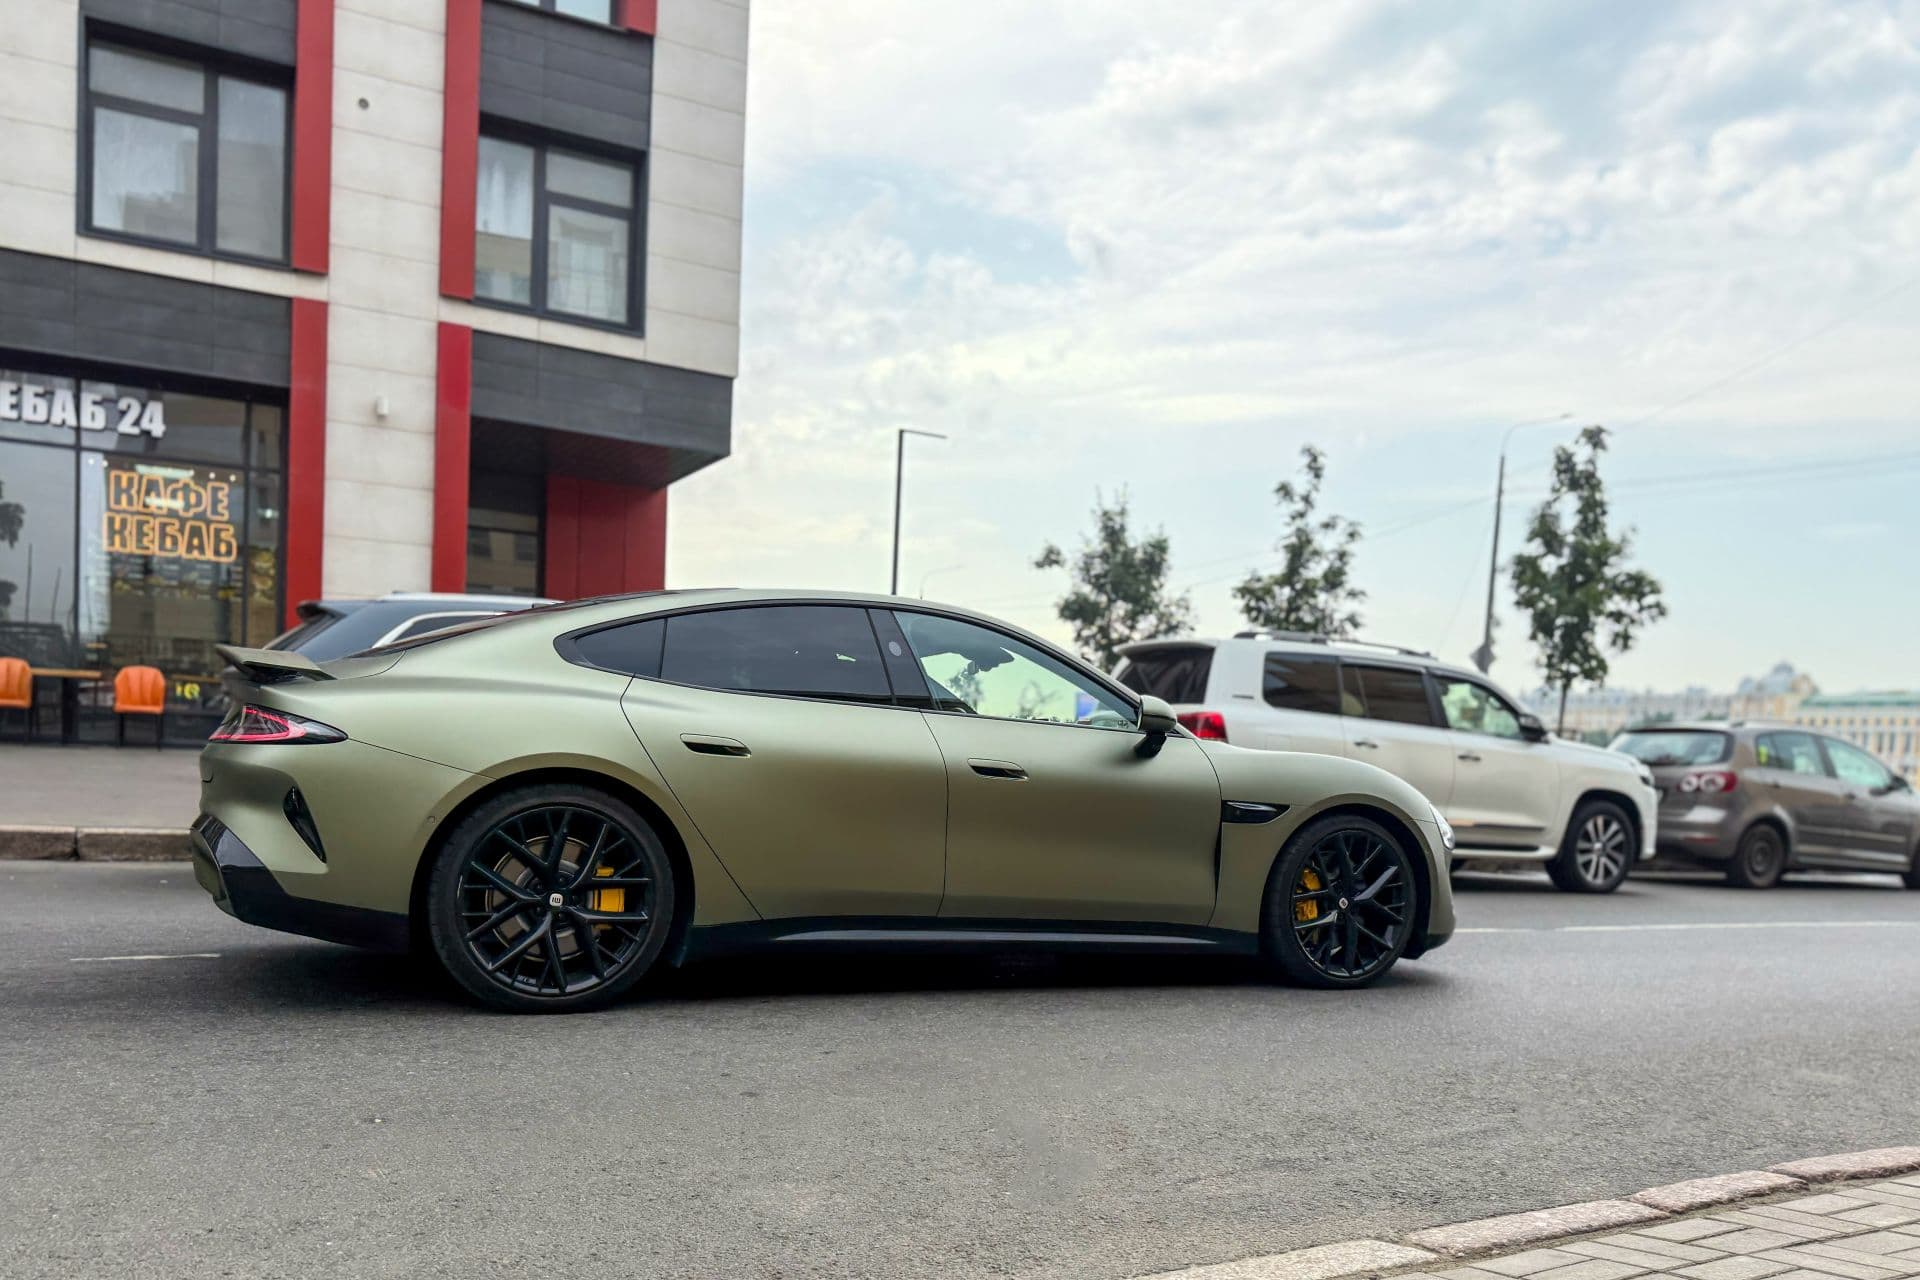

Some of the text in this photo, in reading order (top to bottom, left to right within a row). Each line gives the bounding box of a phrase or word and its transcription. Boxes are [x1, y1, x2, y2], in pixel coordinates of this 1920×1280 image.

[117, 396, 166, 437] 24
[109, 470, 230, 521] КАФЕ
[103, 512, 237, 562] КЕБАБ
